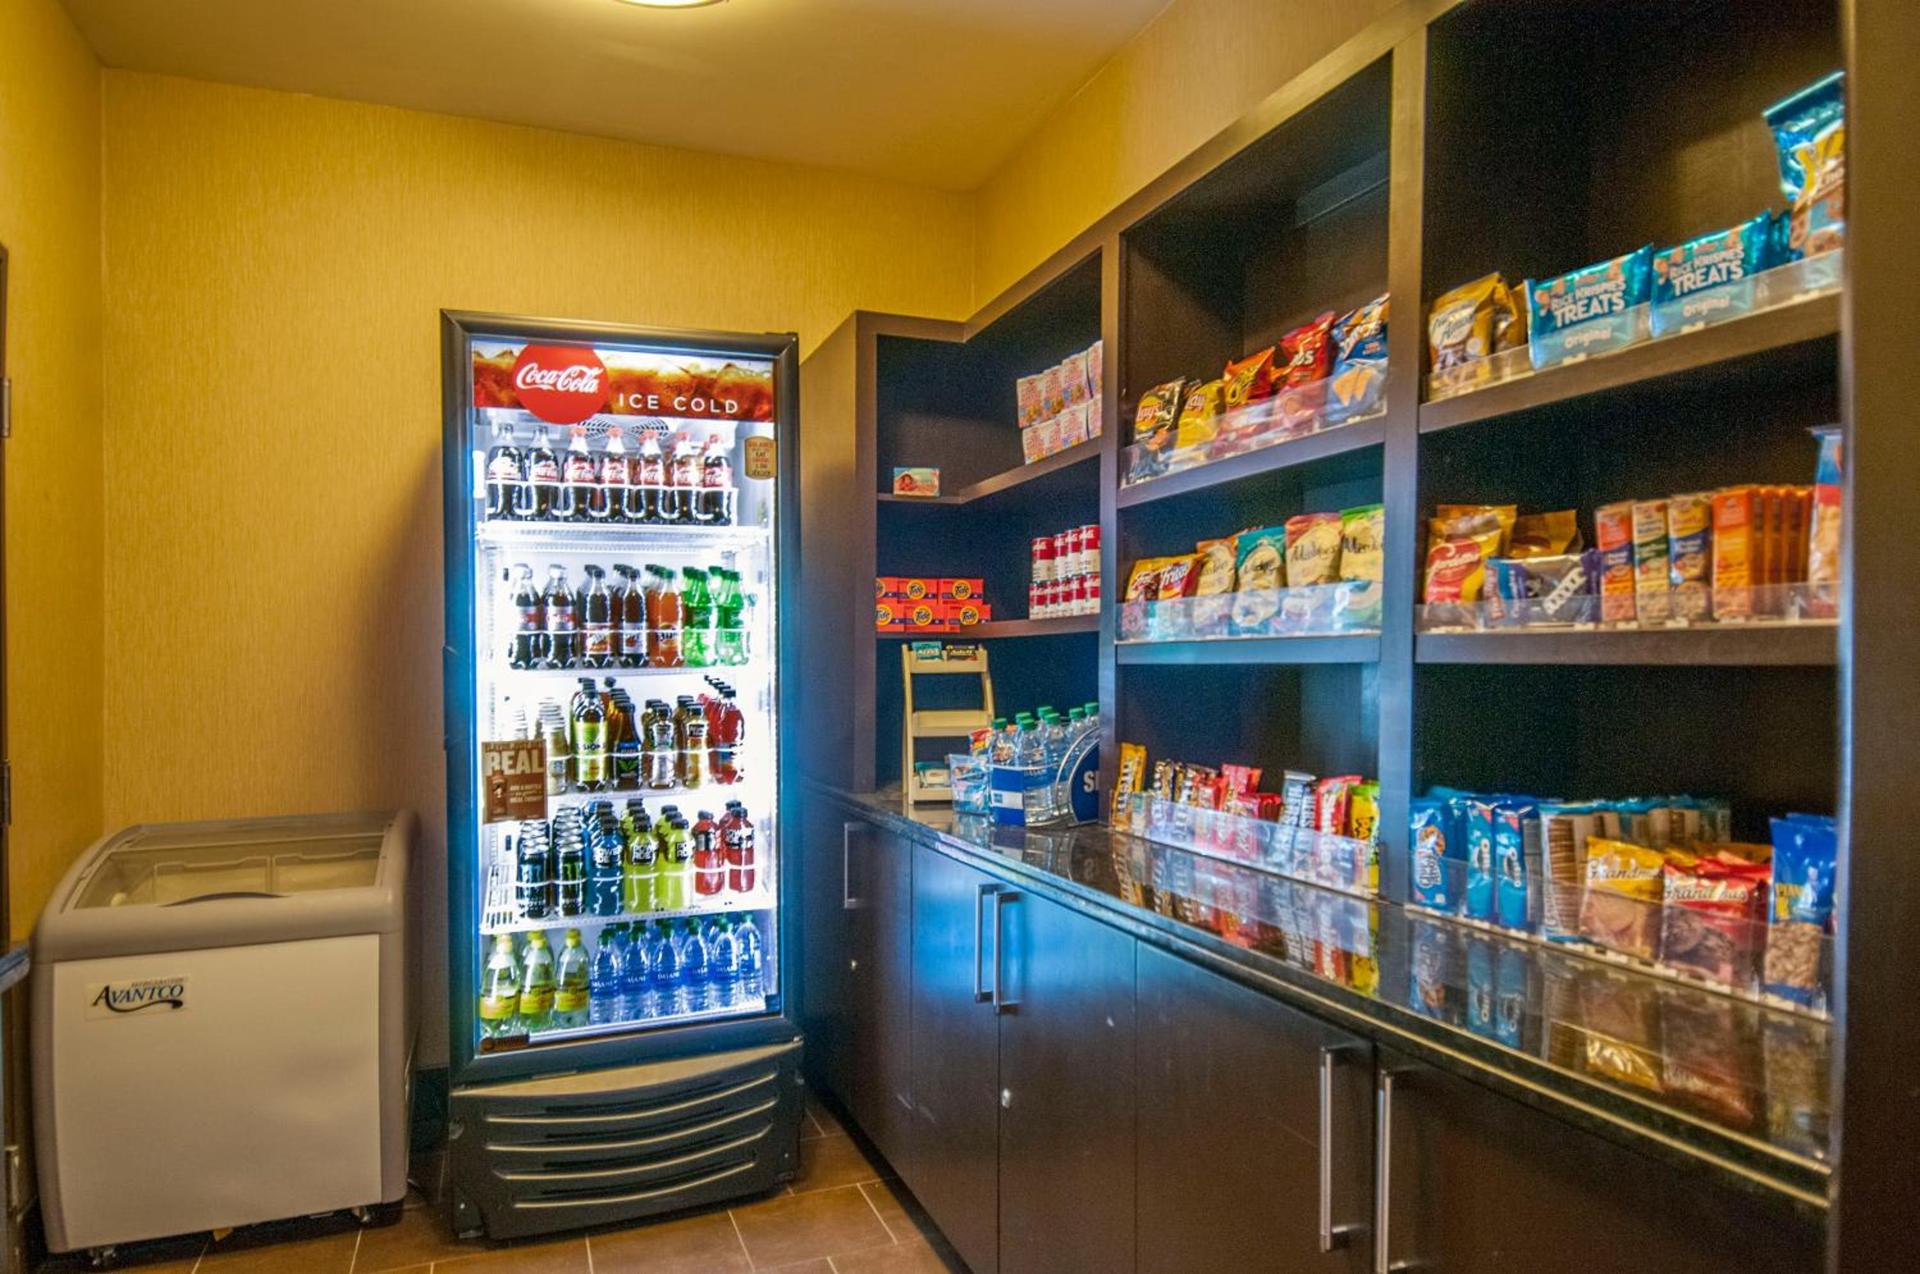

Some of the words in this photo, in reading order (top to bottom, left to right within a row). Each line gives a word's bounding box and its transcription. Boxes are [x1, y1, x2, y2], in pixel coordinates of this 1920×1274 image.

[1672, 259, 1744, 297] TREATS
[1553, 291, 1625, 328] TREATS
[516, 362, 604, 394] Coca-Cola
[618, 393, 660, 410] ICE
[673, 396, 739, 414] COLD
[485, 749, 544, 777] REAL
[92, 984, 184, 1013] AVANTCO
